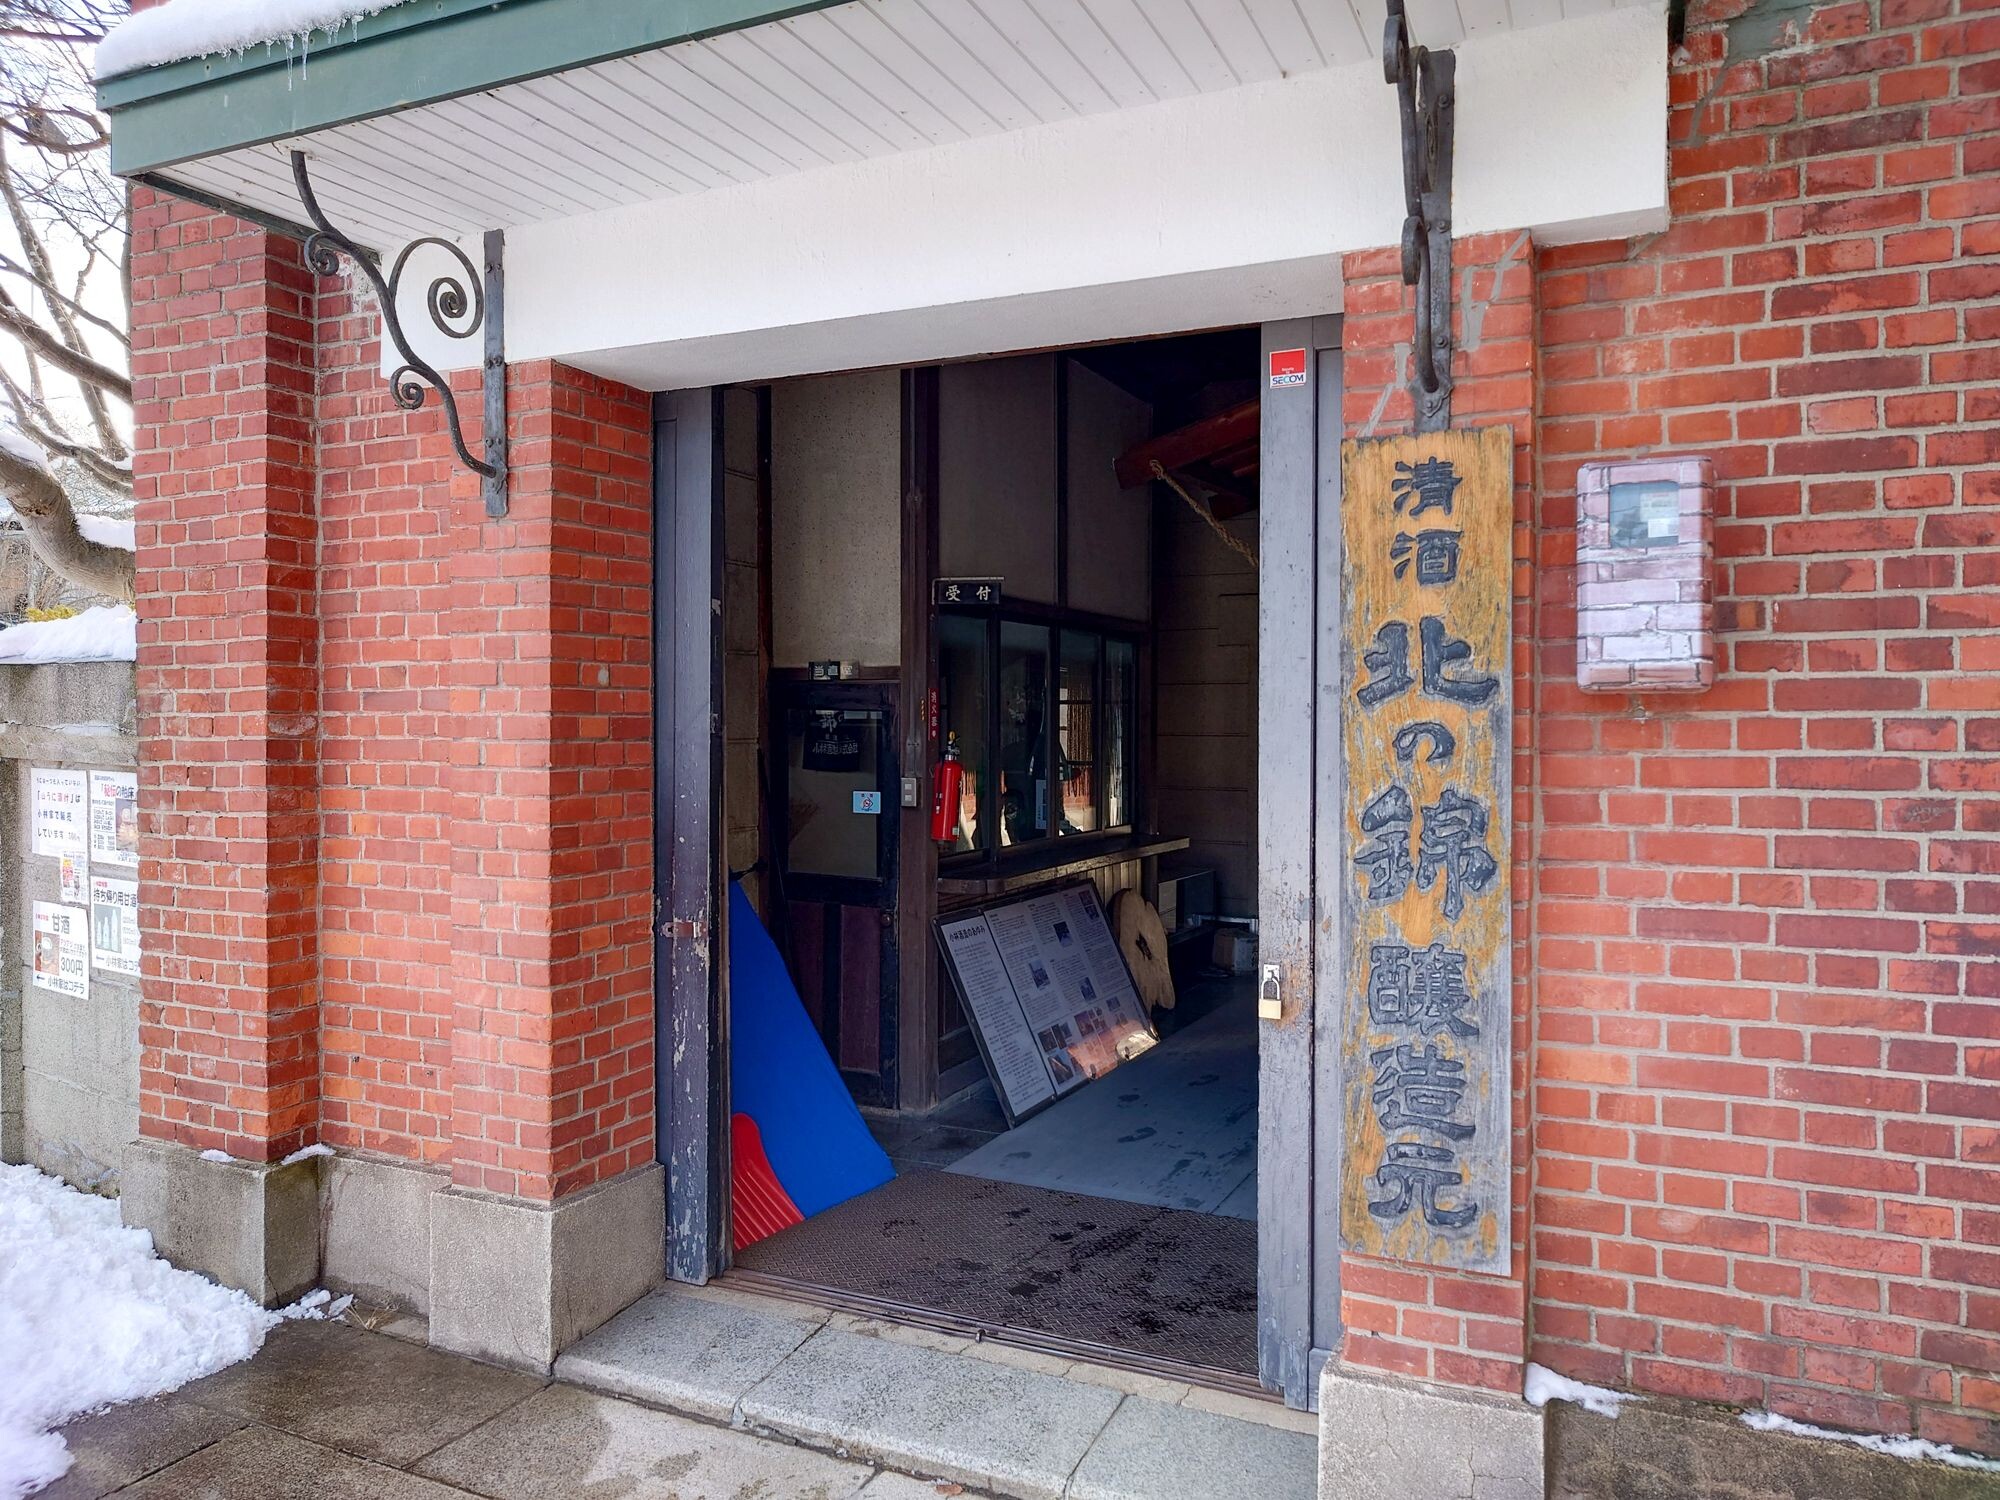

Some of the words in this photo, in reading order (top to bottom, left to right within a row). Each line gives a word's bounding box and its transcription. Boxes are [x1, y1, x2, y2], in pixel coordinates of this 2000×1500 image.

[1272, 374, 1304, 385] SECOM
[1390, 456, 1463, 587] 清酒
[945, 584, 991, 602] 受付
[1354, 614, 1499, 922] 北の錦
[37, 827, 64, 839] しています
[93, 887, 137, 908] 持ち帰り用甘酒
[52, 913, 70, 934] 甘酒
[60, 957, 83, 977] 300円
[1367, 942, 1480, 1229] 醸造元
